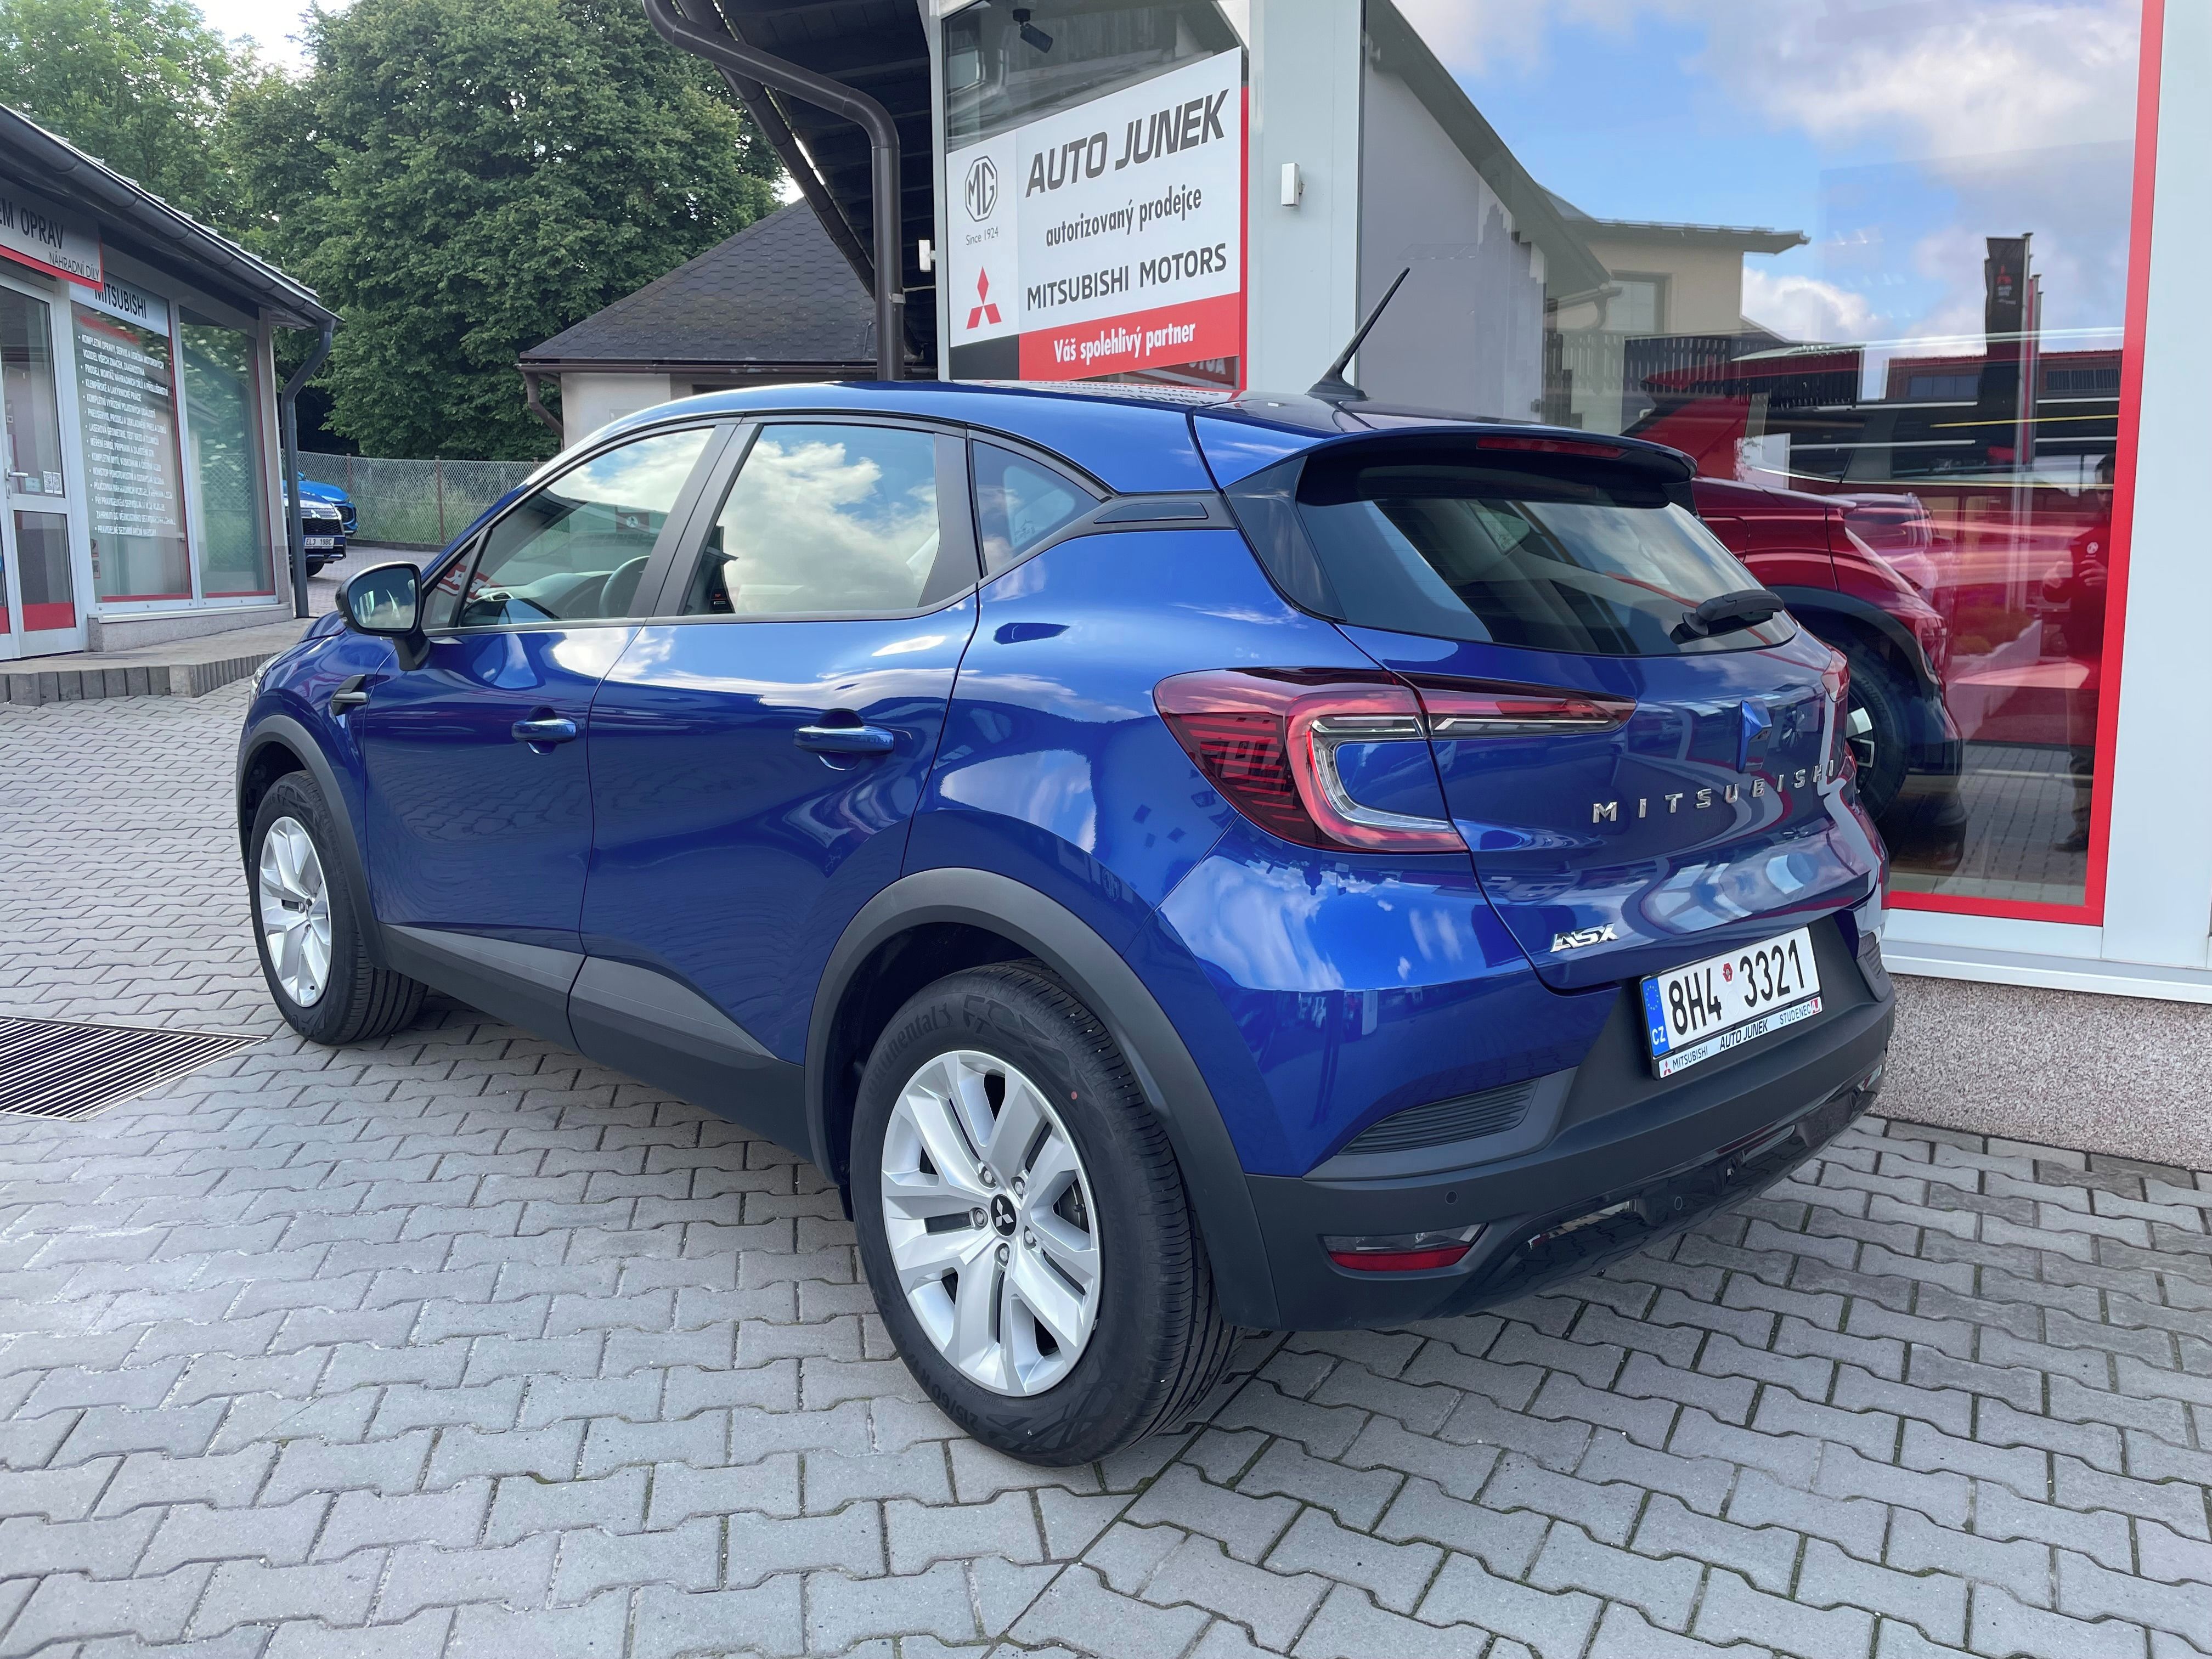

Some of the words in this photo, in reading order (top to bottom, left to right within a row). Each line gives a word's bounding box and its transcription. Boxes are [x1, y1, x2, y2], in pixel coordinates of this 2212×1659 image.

[1025, 132, 1108, 198] AUTO
[1115, 89, 1229, 171] JUNEK
[967, 159, 996, 219] MG
[1046, 199, 1133, 246] autorizovaný
[1139, 184, 1201, 231] prodejce
[0, 198, 14, 229] M
[20, 207, 63, 249] OPRAV
[966, 233, 982, 246] Since
[984, 227, 998, 242] 1924
[49, 250, 84, 276] NÁHRADNÍ
[86, 263, 99, 280] DÍLY
[1027, 266, 1129, 311] MITSUBISHI
[1139, 243, 1227, 287] MOTORS
[1054, 338, 1076, 363] Váš
[1080, 327, 1142, 365] spolehlivý
[1146, 322, 1196, 349] partner
[1592, 759, 1834, 823] MITSUBISHI
[1550, 923, 1618, 952] ASX
[1668, 968, 1722, 1035] 8H4
[1740, 939, 1805, 1007] 3321
[1652, 1025, 1666, 1045] CZ
[1673, 1046, 1708, 1070] MITSUBISHI
[1720, 1030, 1741, 1051] AUTO
[1743, 1019, 1768, 1041] JUNEK
[1780, 1003, 1810, 1025] STUDENEC
